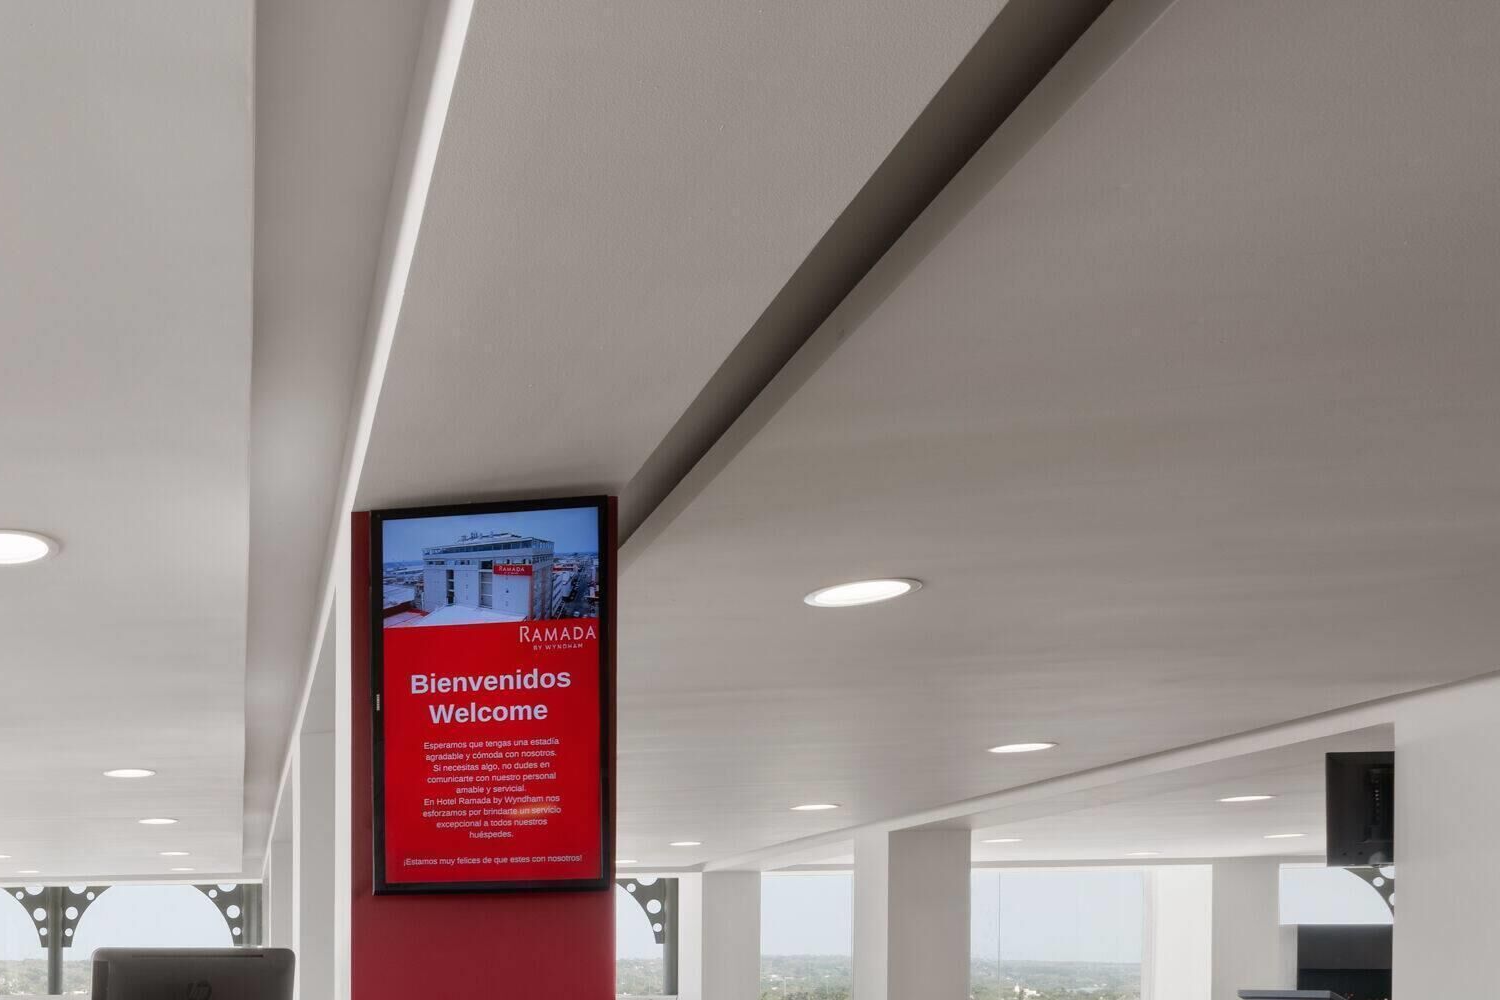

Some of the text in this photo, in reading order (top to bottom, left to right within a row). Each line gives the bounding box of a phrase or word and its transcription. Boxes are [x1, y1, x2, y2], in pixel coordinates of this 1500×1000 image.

[519, 625, 596, 643] RAMADA
[411, 668, 571, 694] Bienvenidos
[429, 702, 548, 724] Welcome
[423, 742, 467, 750] Esperamos
[468, 741, 483, 751] que
[485, 740, 511, 748] tengas
[530, 737, 560, 745] estadía
[425, 753, 464, 762] agradable
[465, 753, 471, 761] y
[472, 751, 503, 759] cómoda
[521, 749, 557, 757] nosotros.
[442, 763, 479, 771] necesitas
[481, 763, 500, 771] algo,
[513, 761, 538, 769] dudes
[427, 775, 474, 783] comunicarte
[491, 773, 521, 781] nuestro
[522, 772, 557, 781] personal
[456, 784, 527, 794] amable y servicial.
[423, 798, 435, 806] En
[436, 797, 457, 805] Hotel
[493, 796, 502, 805] by
[504, 795, 544, 804] Wyndham
[468, 809, 482, 817] por
[483, 807, 518, 815] brindarte
[531, 805, 562, 813] servicio
[436, 820, 482, 828] excepcional
[490, 819, 513, 827] todos
[513, 818, 548, 826] nuestros
[403, 858, 438, 867] ¡Estamos
[439, 858, 456, 866] muy
[493, 856, 508, 865] que
[531, 855, 546, 863] con
[547, 854, 583, 862] nosotros!
